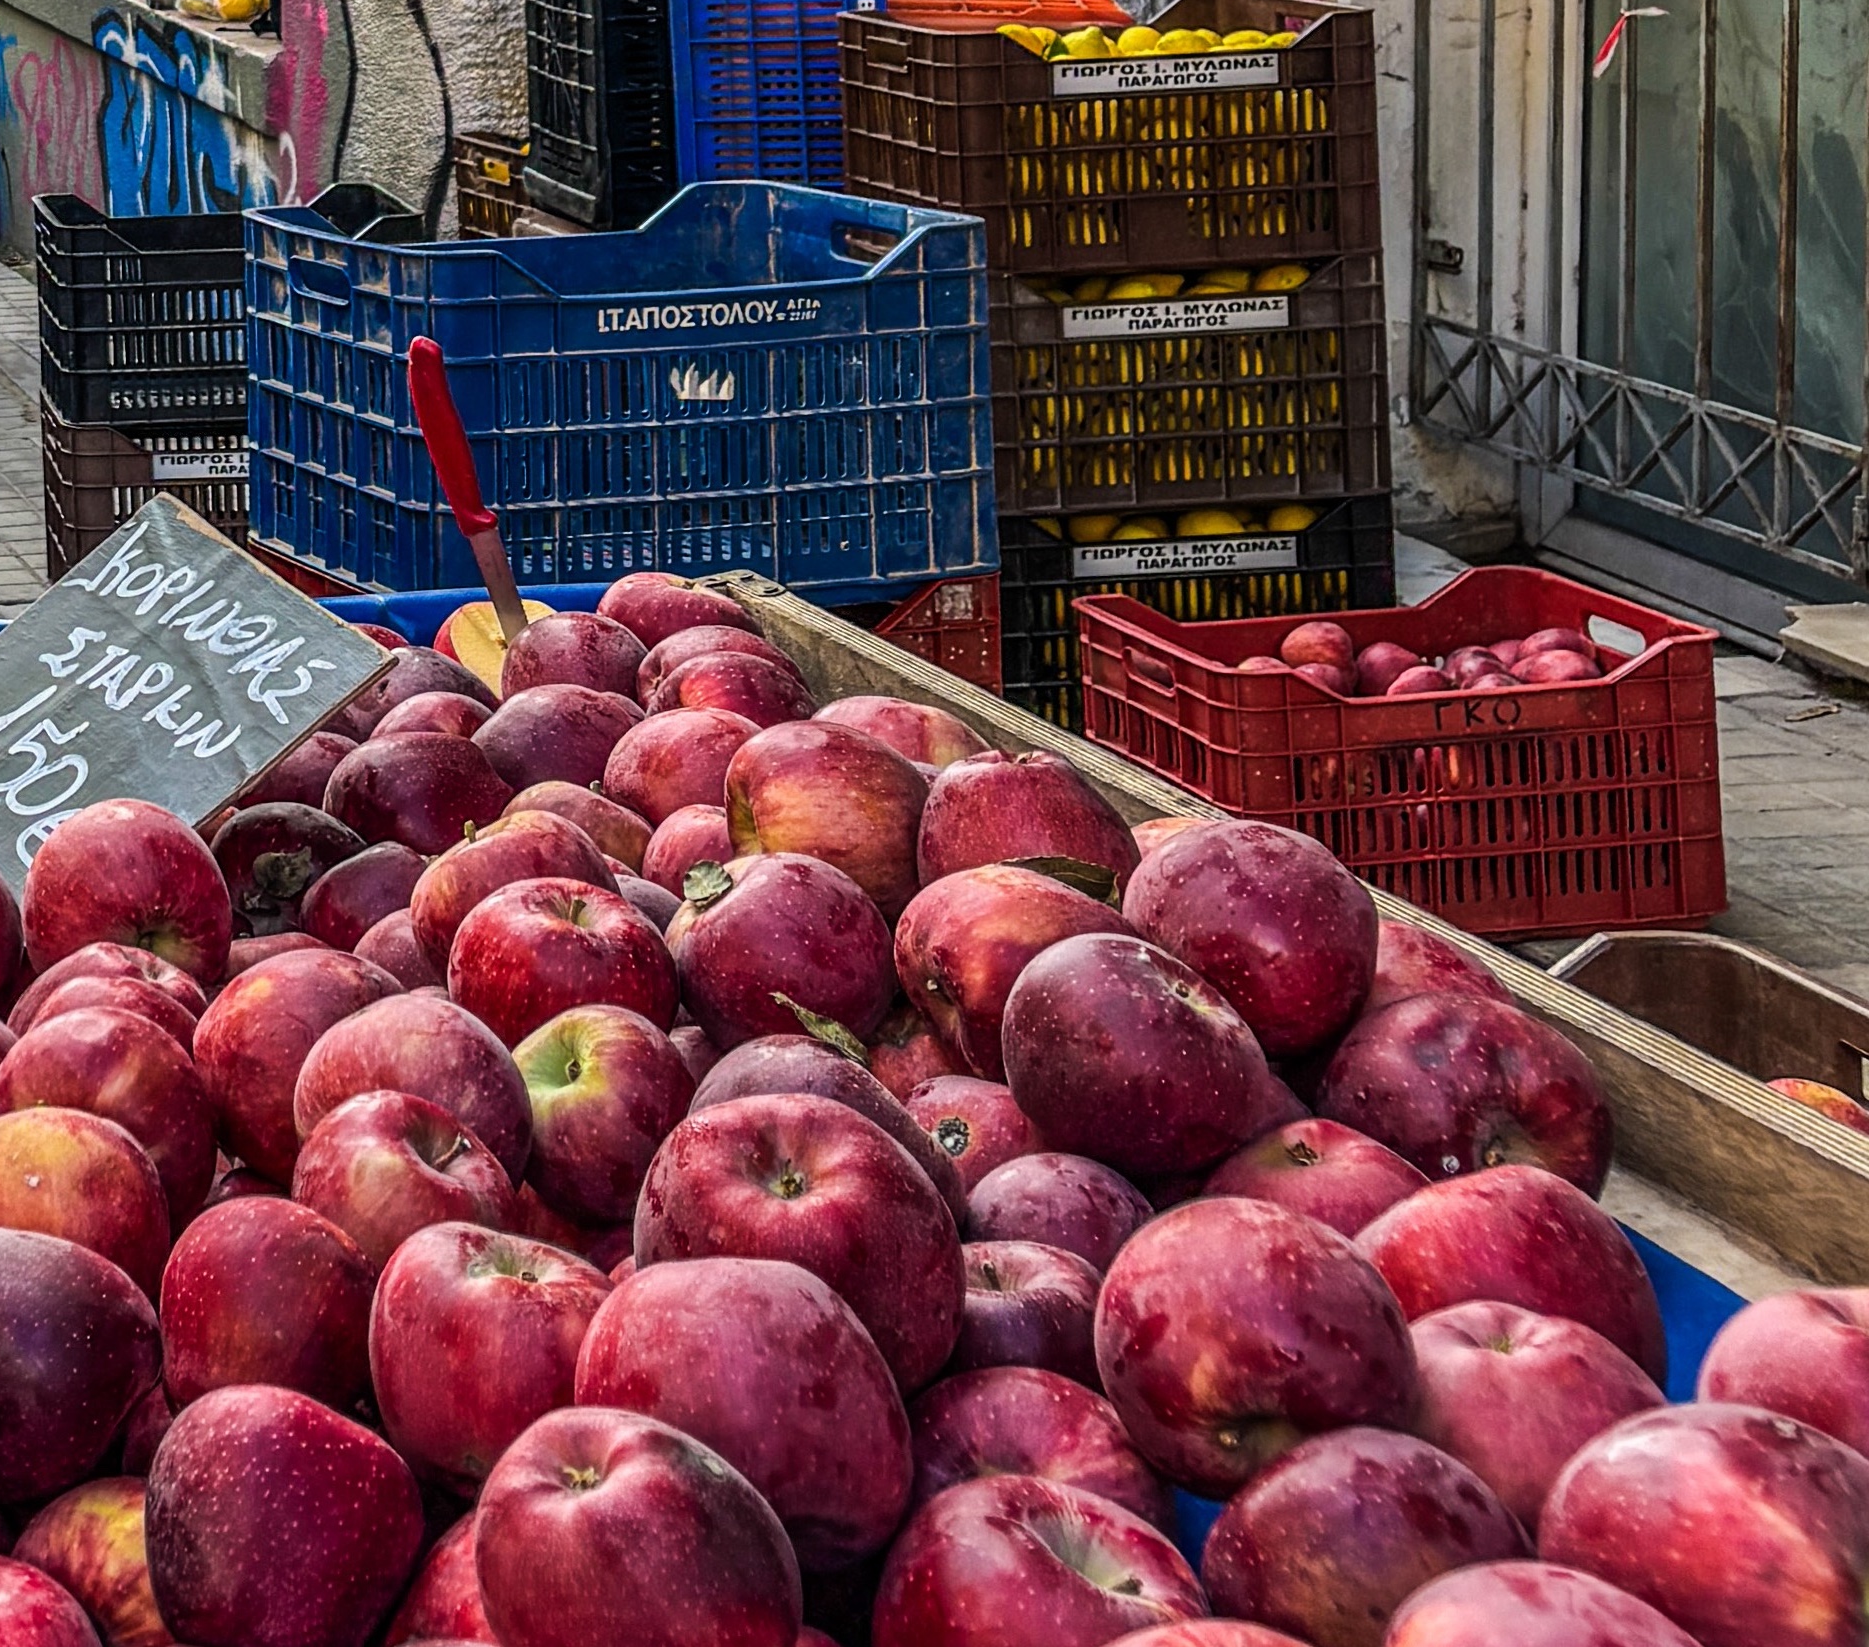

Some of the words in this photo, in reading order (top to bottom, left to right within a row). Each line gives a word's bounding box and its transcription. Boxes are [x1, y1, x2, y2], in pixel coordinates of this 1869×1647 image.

[1060, 63, 1148, 78] ΓΙΩΡΓΟΣ
[1173, 56, 1275, 73] ΜΥΛΩΝΑΣ
[1118, 72, 1219, 88] ΠΑΡΑΓΩΓΟΣ
[1071, 306, 1158, 321] ΓΙΩΡΓΟΣ
[1183, 298, 1284, 315] ΜΥΛΩΝΑΣ
[1128, 314, 1229, 331] ΠΑΡΑΓΩΓΟΣ
[160, 454, 234, 466] ΓΙΩΡΓΟΣ
[1081, 545, 1167, 561] ΓΙΩΡΓΟΣ
[1192, 539, 1293, 555] ΜΥΛΩΝΑΣ
[1136, 554, 1237, 570] ΠΑΡΑΓΩΓΟΣ
